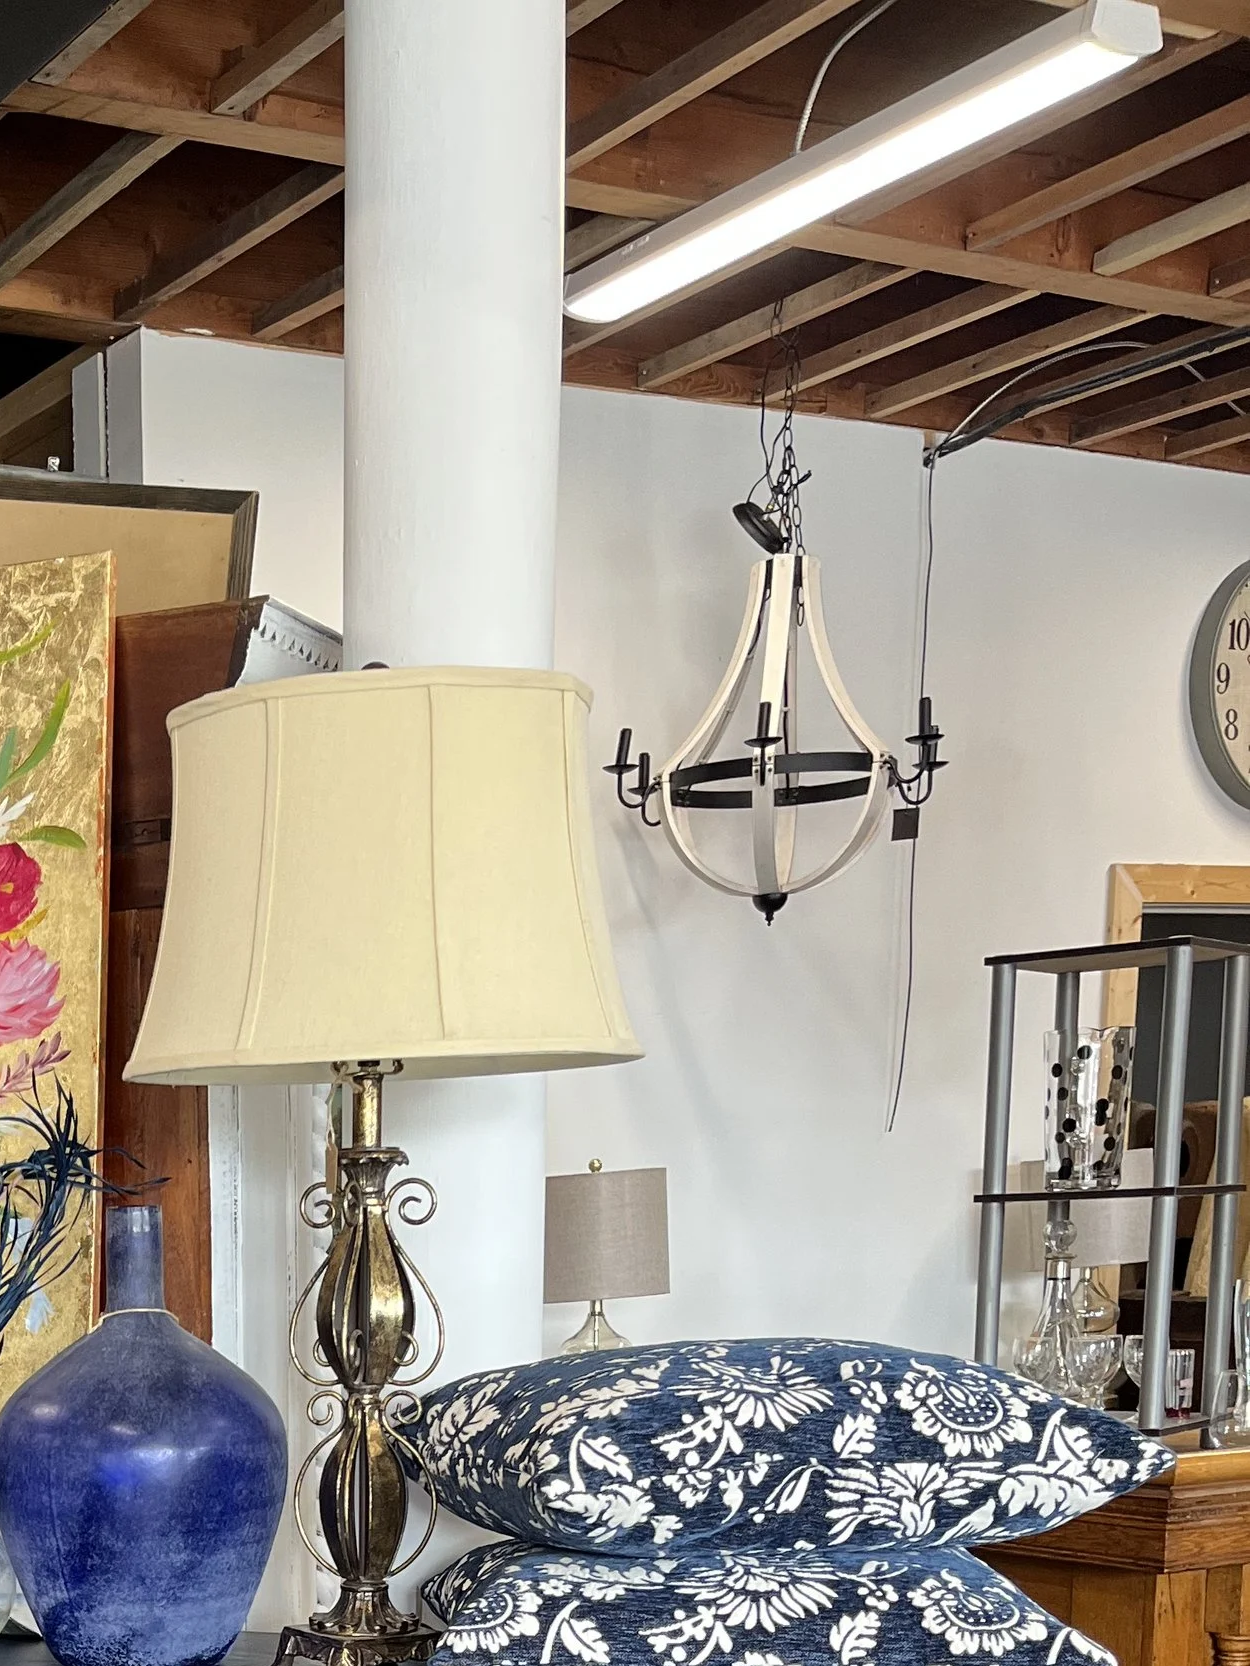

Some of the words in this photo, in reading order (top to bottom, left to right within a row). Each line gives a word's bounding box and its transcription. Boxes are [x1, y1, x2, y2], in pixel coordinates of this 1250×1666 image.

[1228, 617, 1250, 651] 10
[1216, 662, 1231, 695] 9
[1224, 708, 1239, 741] 8
